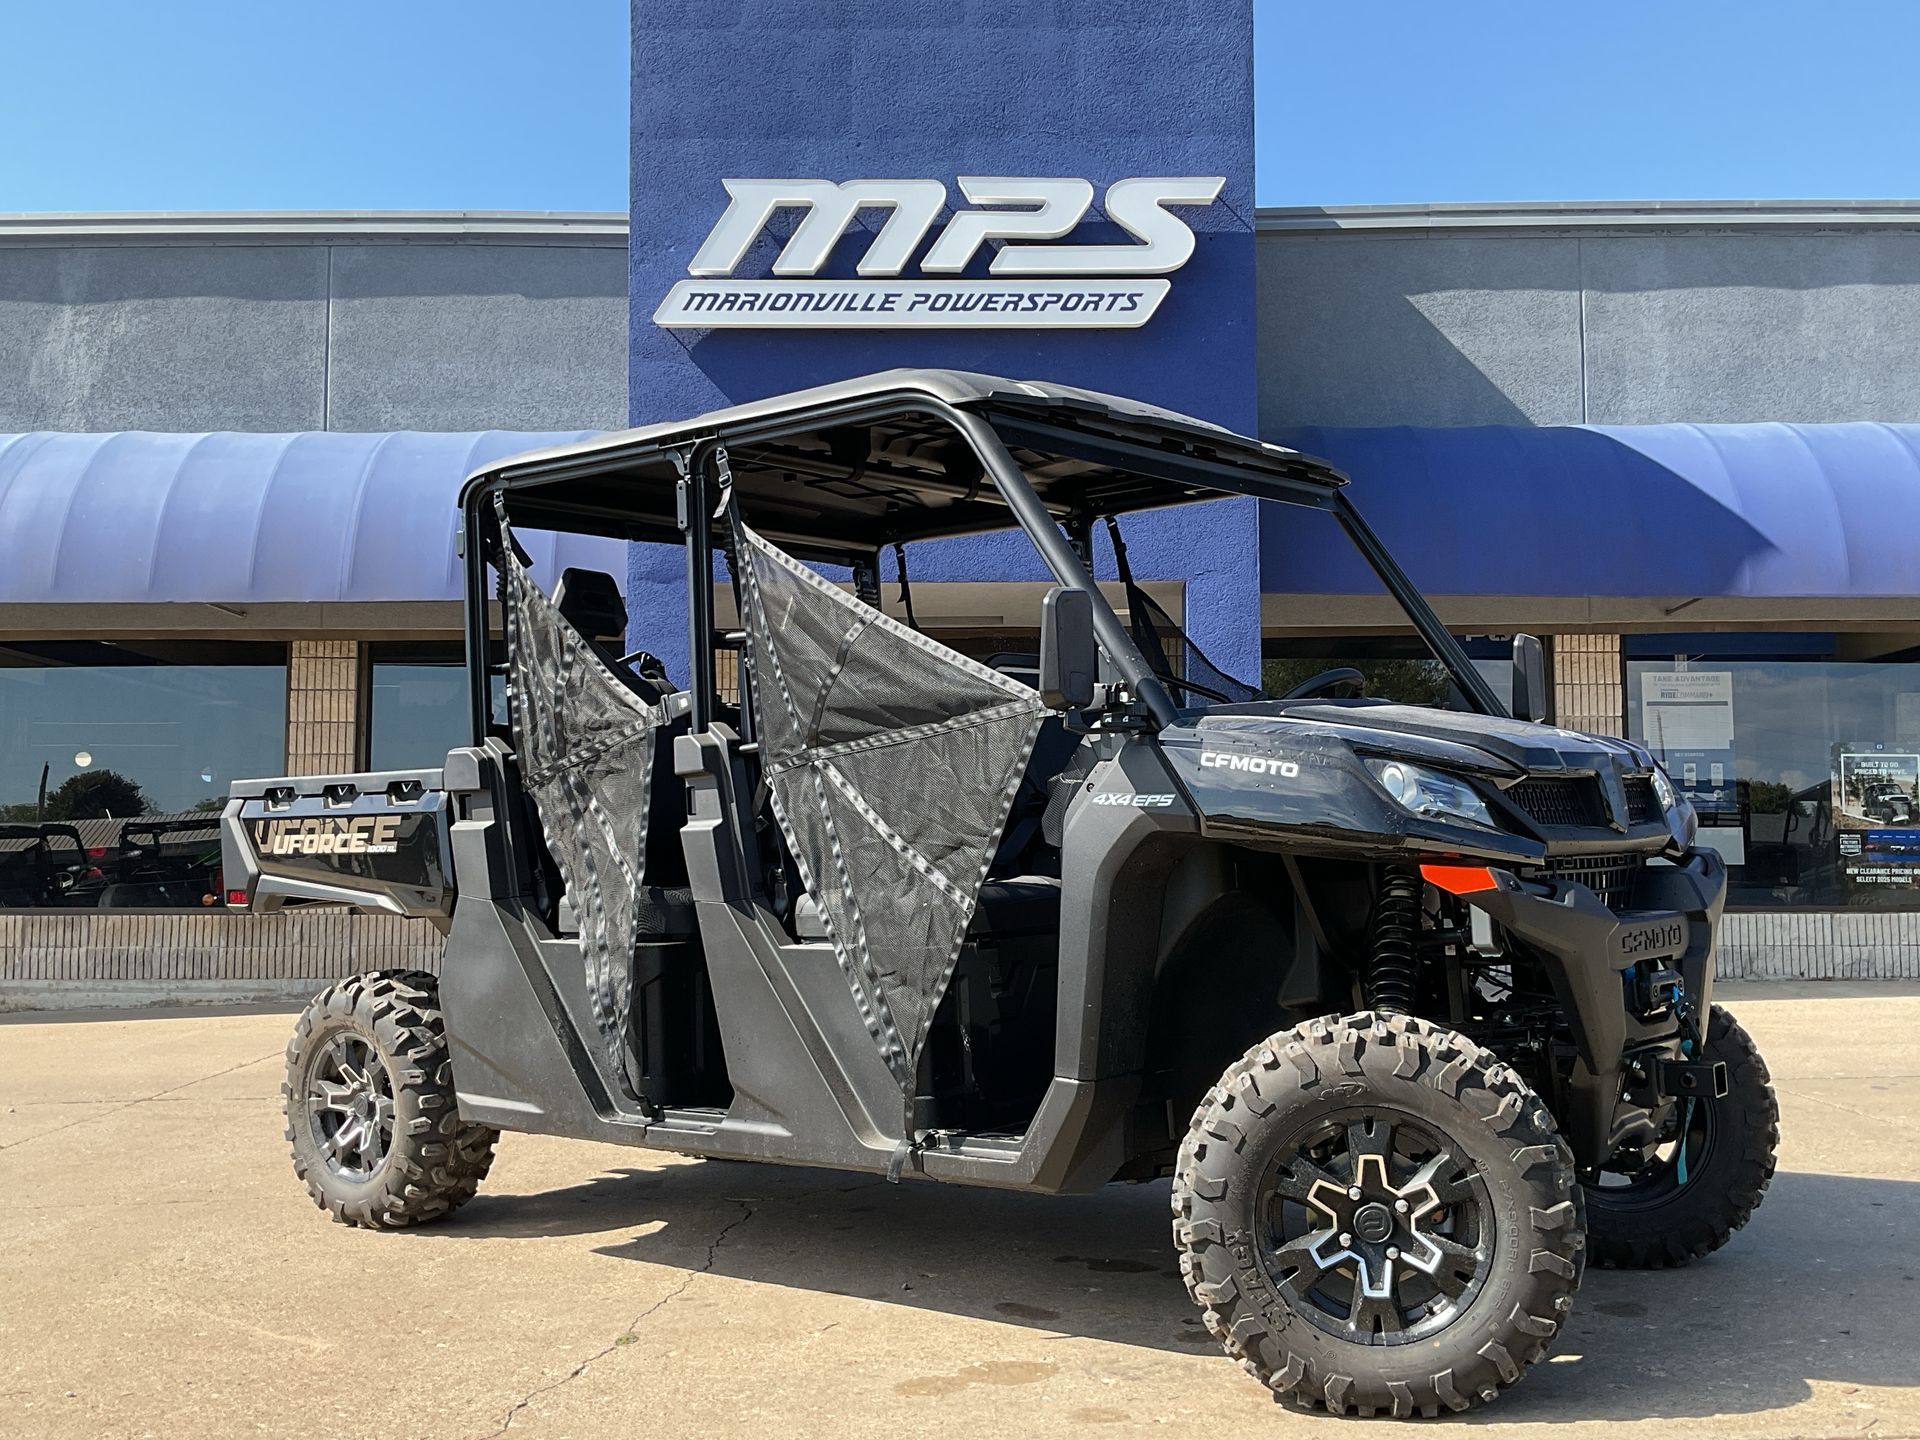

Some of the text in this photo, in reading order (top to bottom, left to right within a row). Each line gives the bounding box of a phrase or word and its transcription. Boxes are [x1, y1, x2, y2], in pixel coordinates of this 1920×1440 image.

[688, 176, 1226, 275] MPS
[682, 292, 1144, 313] MARIONVILLE POWERSPORTS
[1200, 752, 1299, 778] CFMOTO
[273, 833, 369, 854] UFORCE
[1846, 867, 1859, 875] NEW
[1860, 867, 1891, 875] CLEARANCE
[1621, 924, 1682, 954] CFMOTO
